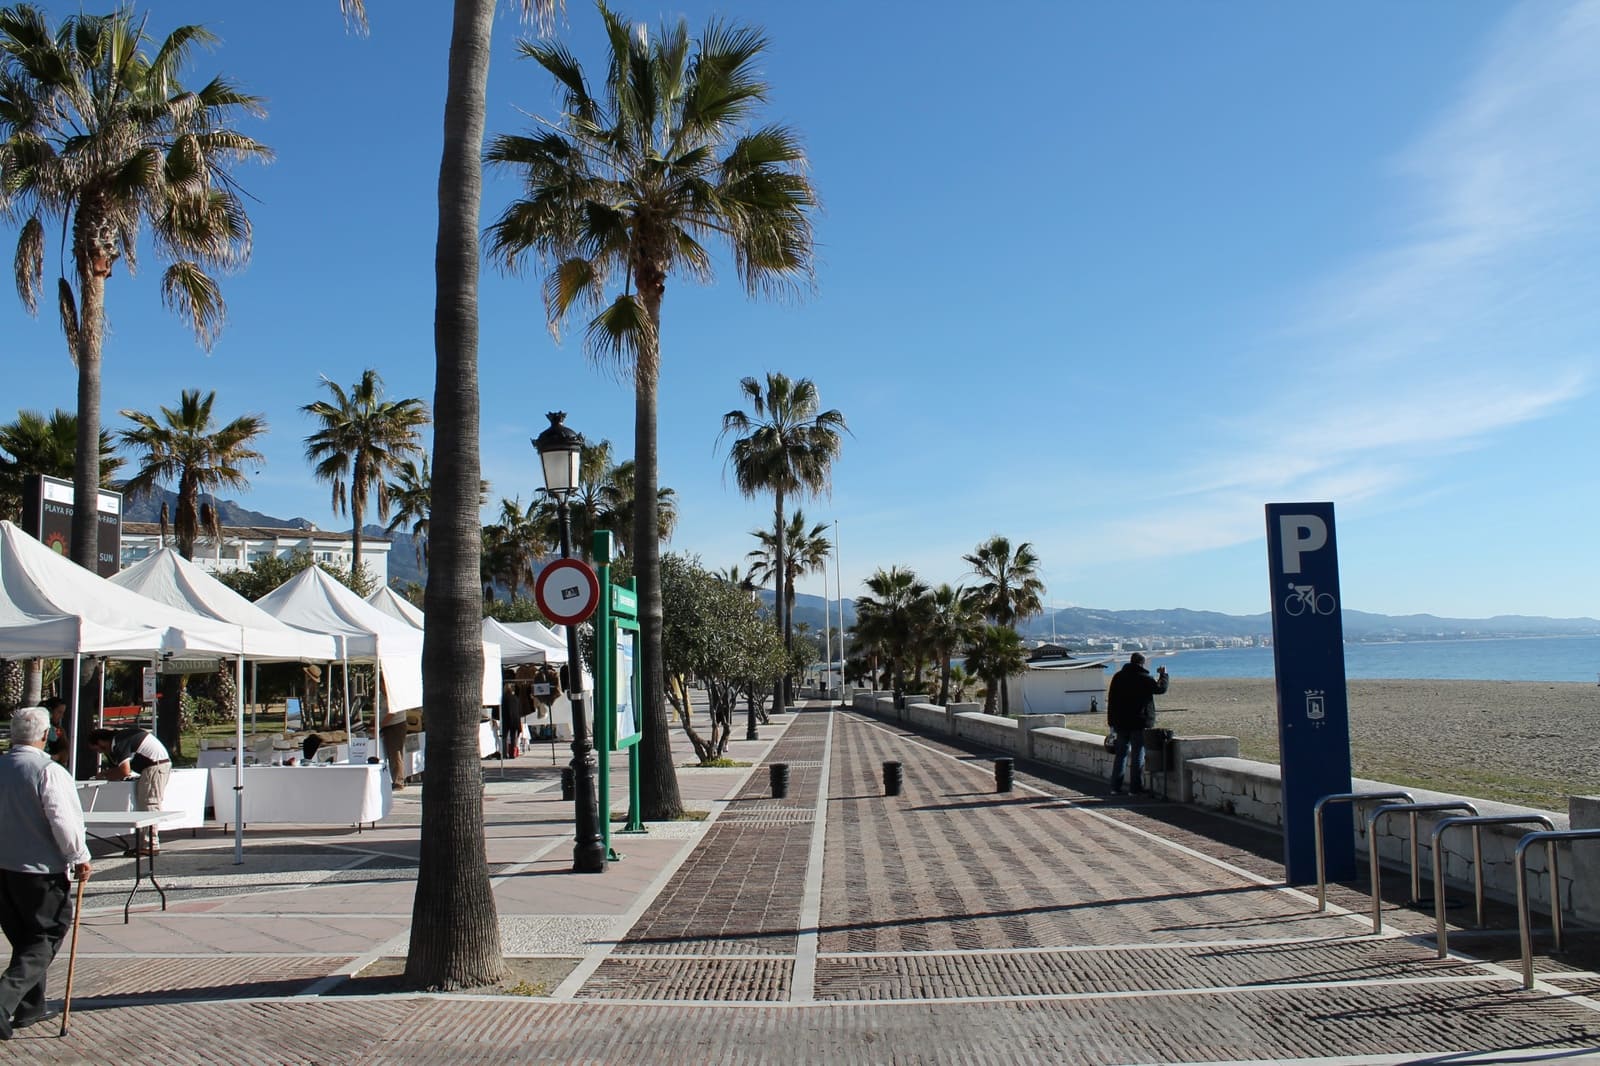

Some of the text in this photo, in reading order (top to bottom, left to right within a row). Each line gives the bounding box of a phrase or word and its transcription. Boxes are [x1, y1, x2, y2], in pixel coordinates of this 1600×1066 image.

[44, 503, 65, 514] PLAYA
[1280, 514, 1327, 573] P
[99, 552, 114, 563] SUN
